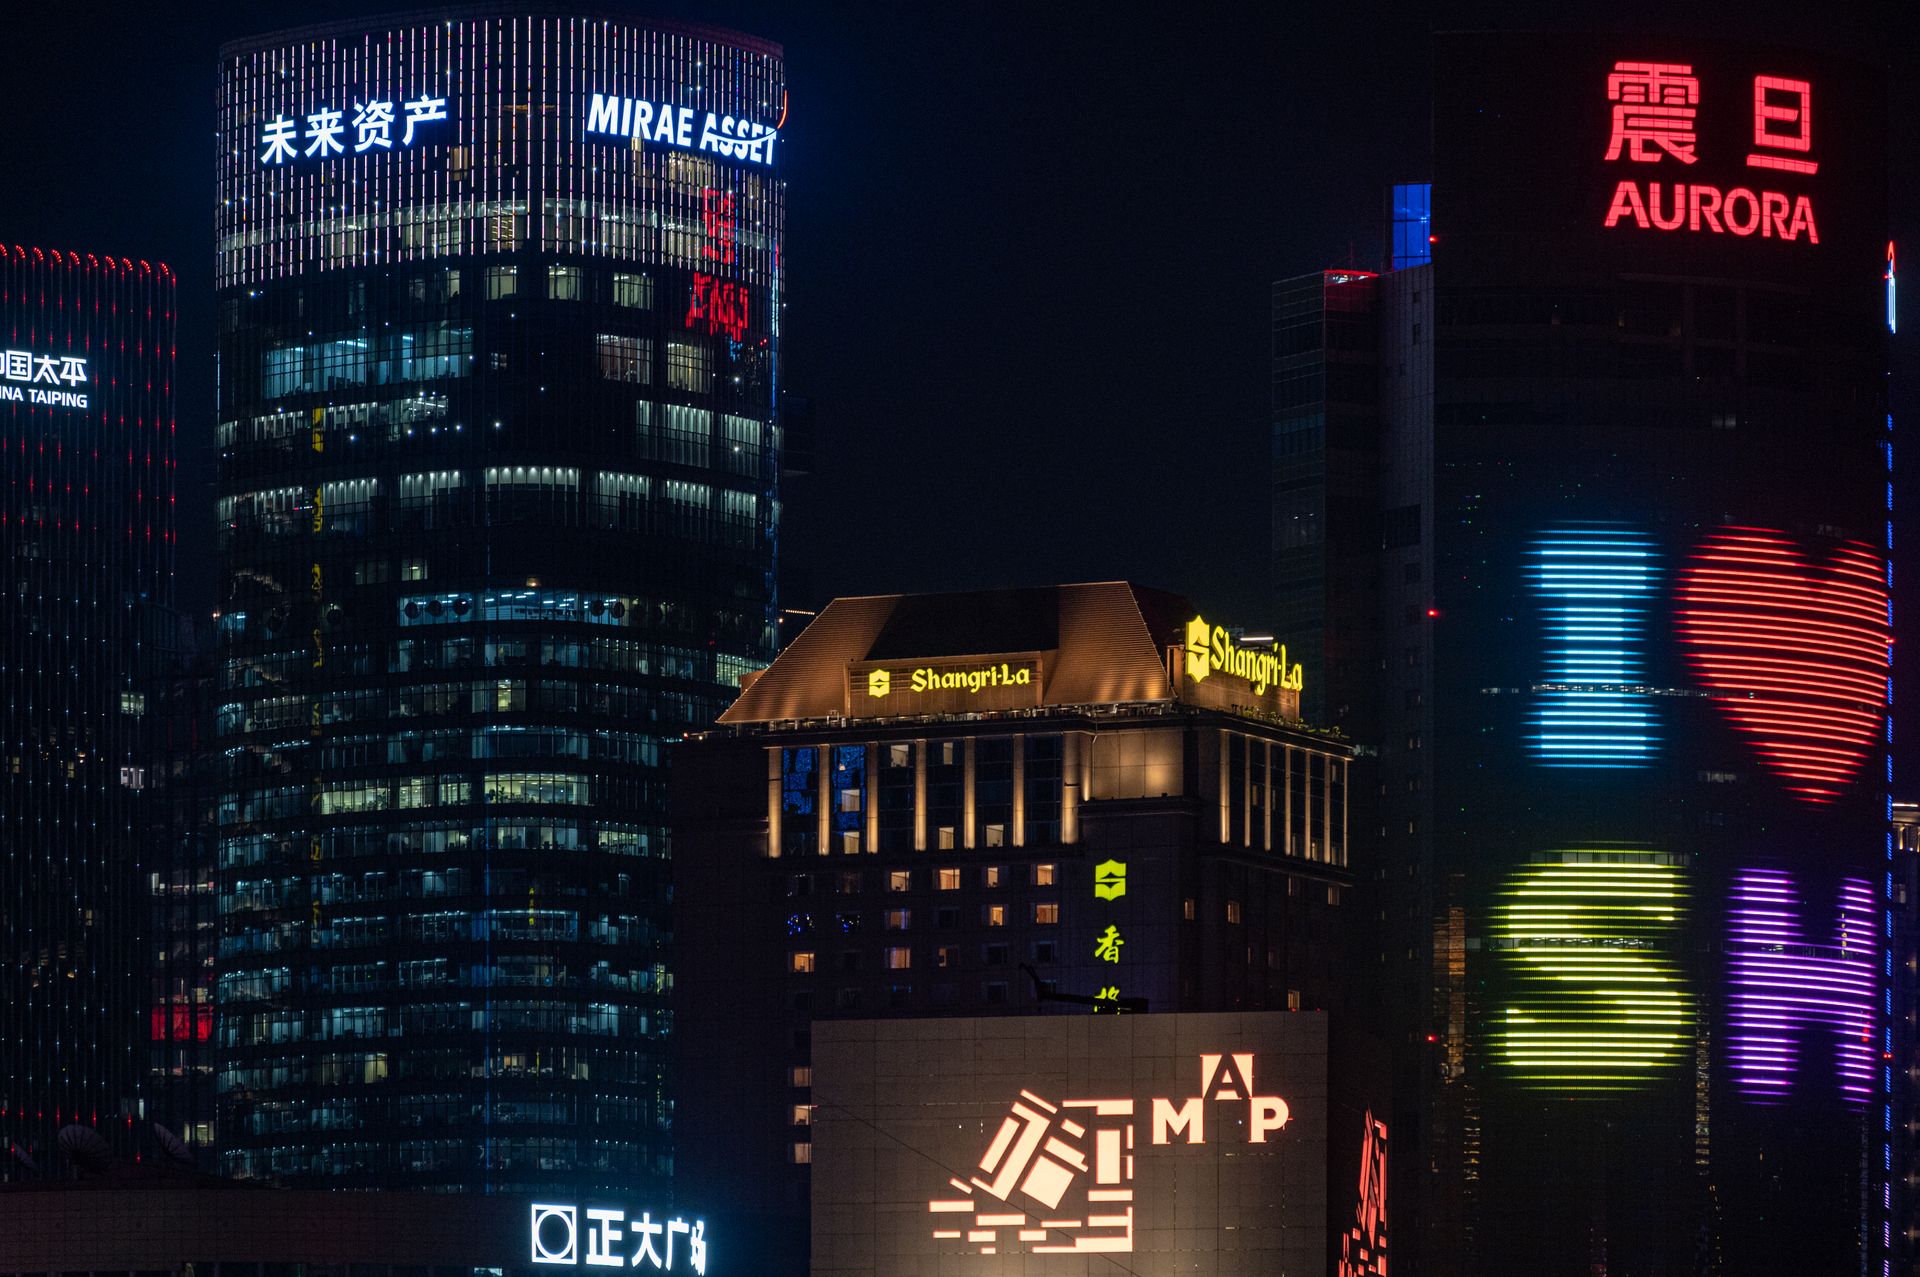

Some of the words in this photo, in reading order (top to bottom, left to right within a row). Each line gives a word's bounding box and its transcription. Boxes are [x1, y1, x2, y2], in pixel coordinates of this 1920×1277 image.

[260, 94, 447, 165] 未来资产
[587, 93, 694, 147] MIRAE
[699, 112, 777, 165] ASSET
[1605, 61, 1818, 174] 震旦
[1604, 181, 1819, 244] AURORA
[0, 350, 87, 387] 国太平
[28, 388, 88, 409] TAIPING
[911, 663, 1030, 693] Shangri-La
[1210, 626, 1303, 696] Shangri-La
[1152, 1053, 1290, 1144] MAP
[586, 1208, 707, 1276] 正大广场
